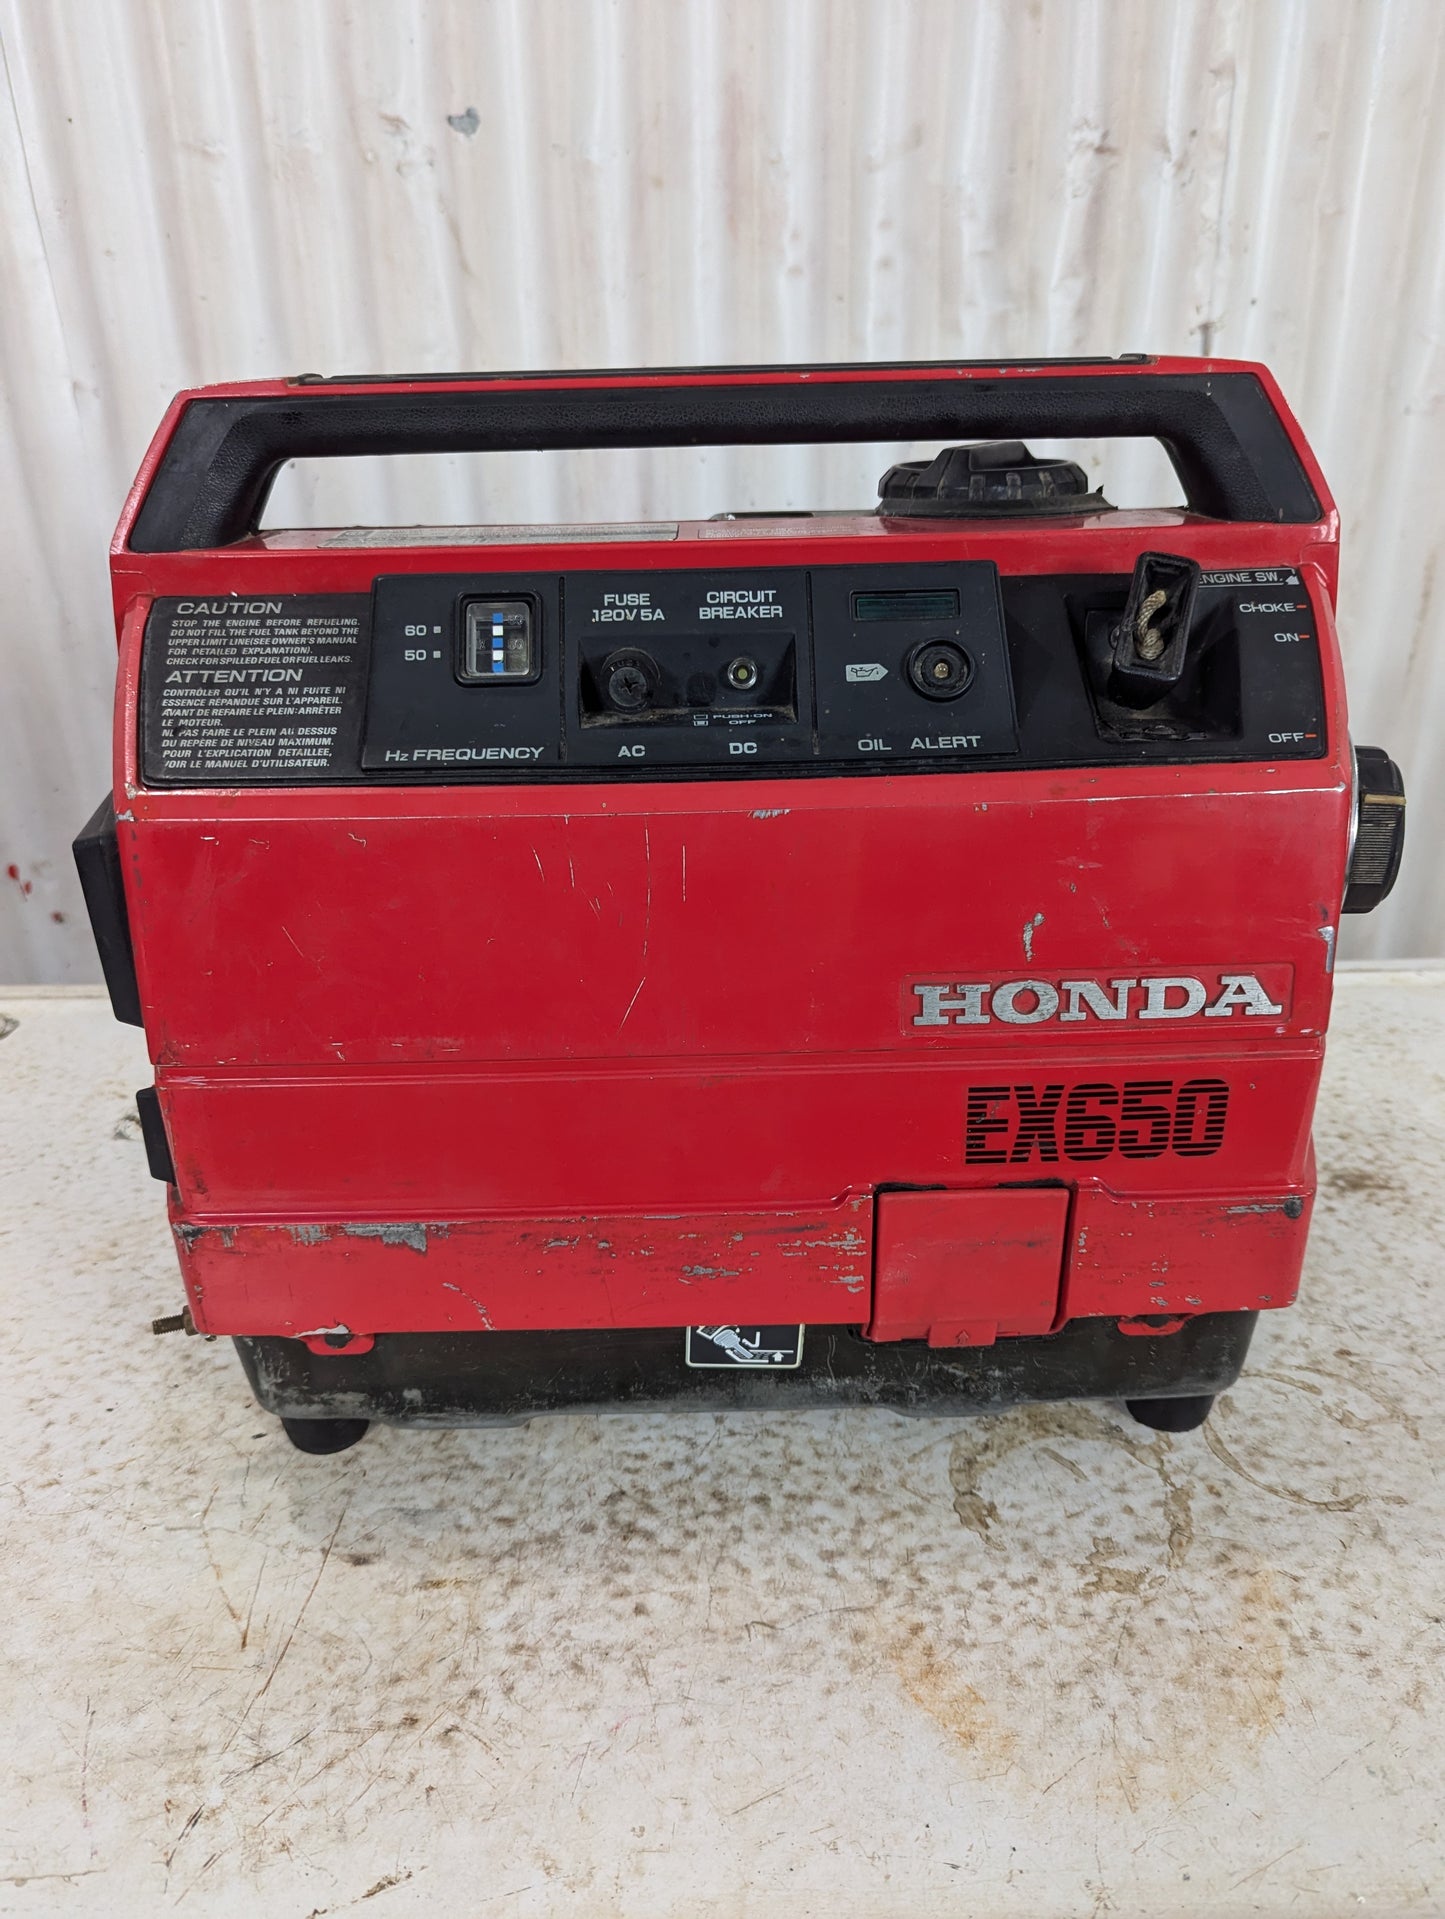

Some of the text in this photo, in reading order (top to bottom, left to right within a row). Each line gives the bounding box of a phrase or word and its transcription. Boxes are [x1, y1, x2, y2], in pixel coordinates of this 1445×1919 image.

[1255, 571, 1283, 583] SW.
[604, 593, 651, 606] FUSE
[707, 590, 776, 604] CIRCUIT
[177, 602, 282, 615] CAUTION
[699, 605, 783, 620] BREAKER
[1239, 602, 1296, 613] CHOKE
[593, 608, 665, 622] 120V 5A
[203, 619, 221, 627] THE
[226, 619, 261, 627] ENGINE
[266, 618, 302, 626] BEFORE
[307, 618, 360, 626] REFUELING.
[170, 629, 185, 637] DO
[186, 628, 206, 637] NOT
[208, 628, 226, 636] FILL
[229, 628, 246, 636] THE
[249, 628, 272, 636] FUEL
[274, 628, 299, 636] TANK
[341, 627, 359, 635] THE
[404, 625, 427, 636] 60
[168, 638, 200, 646] UPPER
[1274, 632, 1300, 642] ON
[168, 646, 312, 656] FOR DETAILED EXPLANATION).
[404, 650, 426, 661] 50
[200, 657, 219, 665] FOR
[220, 656, 258, 665] SPILLED
[258, 656, 281, 664] FUEL
[282, 656, 296, 664] OR
[296, 656, 320, 664] FUEL
[320, 655, 352, 663] LEAKS.
[165, 670, 303, 683] ATTENTION
[224, 688, 250, 696] QU'IL
[254, 687, 272, 696] N'Y
[275, 687, 282, 695] A
[288, 686, 299, 694] NI
[303, 686, 332, 694] FUITE
[335, 686, 346, 694] NI
[162, 698, 206, 707] ESSENCE
[263, 697, 284, 706] SUR
[286, 696, 343, 704] L'APPAREIL.
[162, 708, 196, 716] AVANT
[196, 708, 210, 716] DE
[212, 708, 252, 716] REFAIRE
[254, 708, 264, 716] LE
[162, 718, 223, 727] LE MOTEUR.
[202, 728, 231, 736] FAIRE
[234, 728, 246, 736] LE
[248, 728, 276, 736] PLEIN
[298, 727, 338, 736] DESSUS
[162, 739, 178, 748] DU
[220, 738, 234, 747] DE
[237, 738, 276, 747] NIVEAU
[278, 738, 334, 746] MAXIMUM.
[858, 735, 982, 751] OIL ALERT
[1268, 732, 1304, 744] OFF
[162, 749, 192, 758] POUR
[198, 748, 272, 757] L'EXPLICATION
[618, 745, 646, 757] AC
[729, 742, 758, 754] DC
[385, 746, 544, 762] Hz FREQUENCY
[190, 760, 202, 768] LE
[205, 760, 248, 768] MANUEL
[252, 758, 330, 768] D'UTILISATEUR.
[913, 975, 1282, 1026] HONDA
[965, 1078, 1230, 1165] EX650
